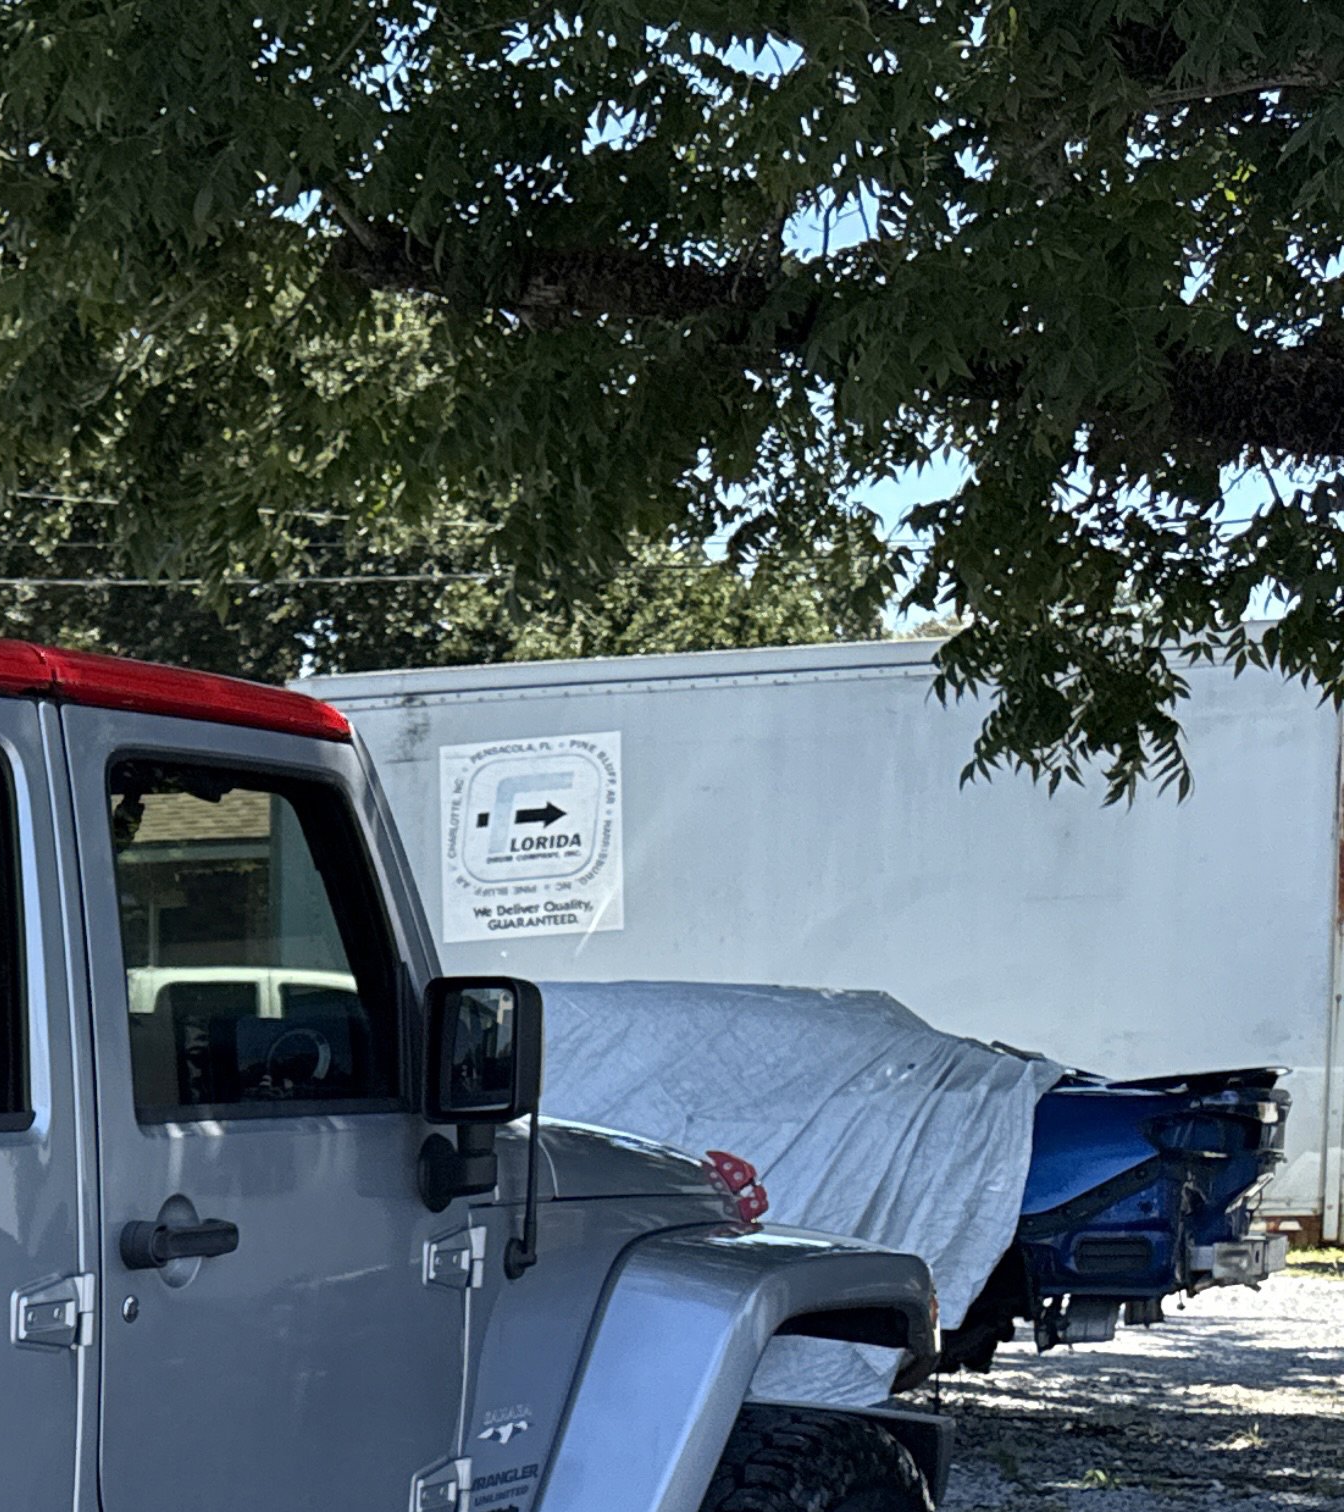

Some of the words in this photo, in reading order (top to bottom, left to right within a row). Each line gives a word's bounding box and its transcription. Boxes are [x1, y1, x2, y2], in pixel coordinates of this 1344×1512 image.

[473, 906, 492, 918] We
[497, 903, 540, 916] Deliver
[544, 900, 593, 913] Quality,
